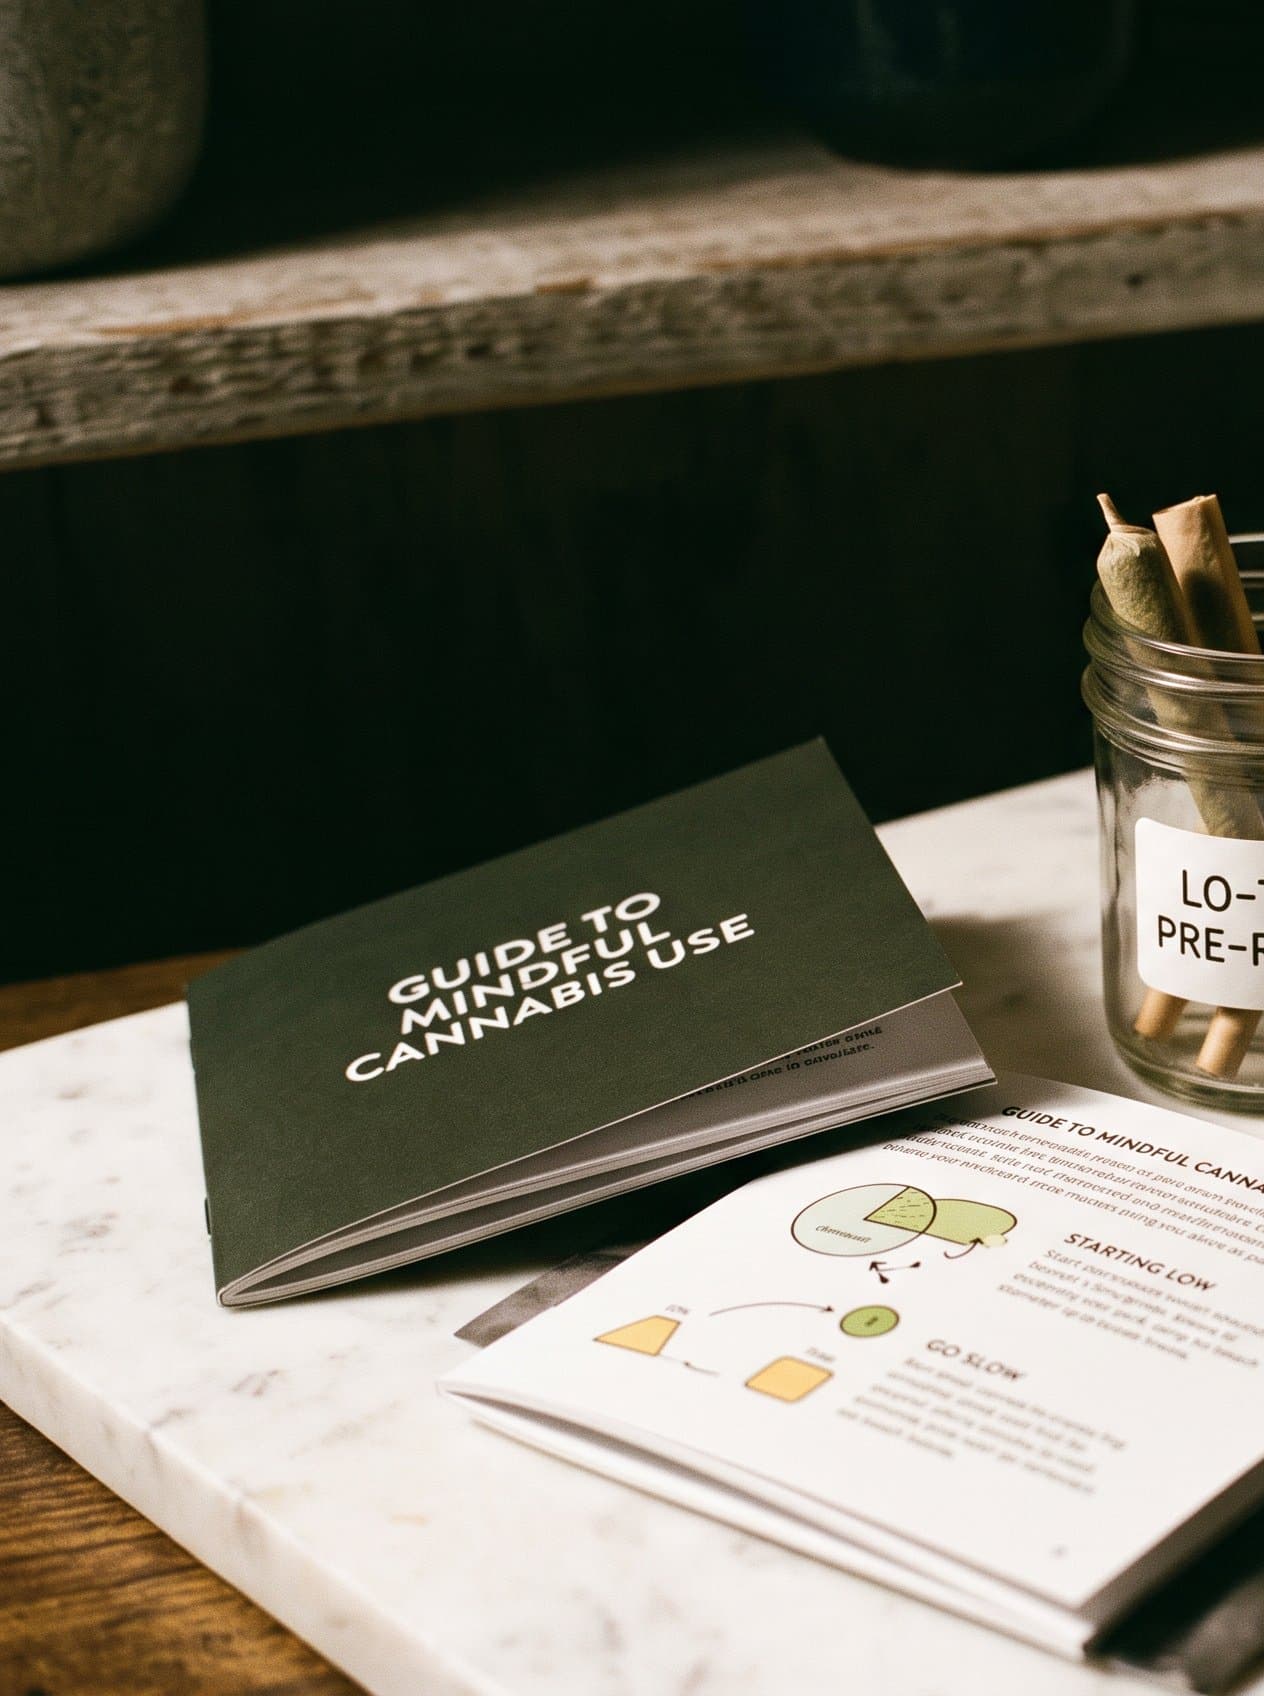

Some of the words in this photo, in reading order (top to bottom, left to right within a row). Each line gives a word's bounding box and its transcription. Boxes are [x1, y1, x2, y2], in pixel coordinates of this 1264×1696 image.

[387, 922, 573, 1005] GUIDE
[580, 892, 661, 934] TO
[401, 921, 671, 1035] MINDFUL
[344, 960, 636, 1082] CANNABIS
[646, 913, 755, 970] USE
[1001, 1105, 1068, 1129] GUIDE
[1068, 1122, 1096, 1137] TO
[1095, 1131, 1190, 1168] MINDFUL
[1064, 1232, 1166, 1275] STARTING
[1165, 1267, 1217, 1292] LOW
[926, 1338, 961, 1358] GO
